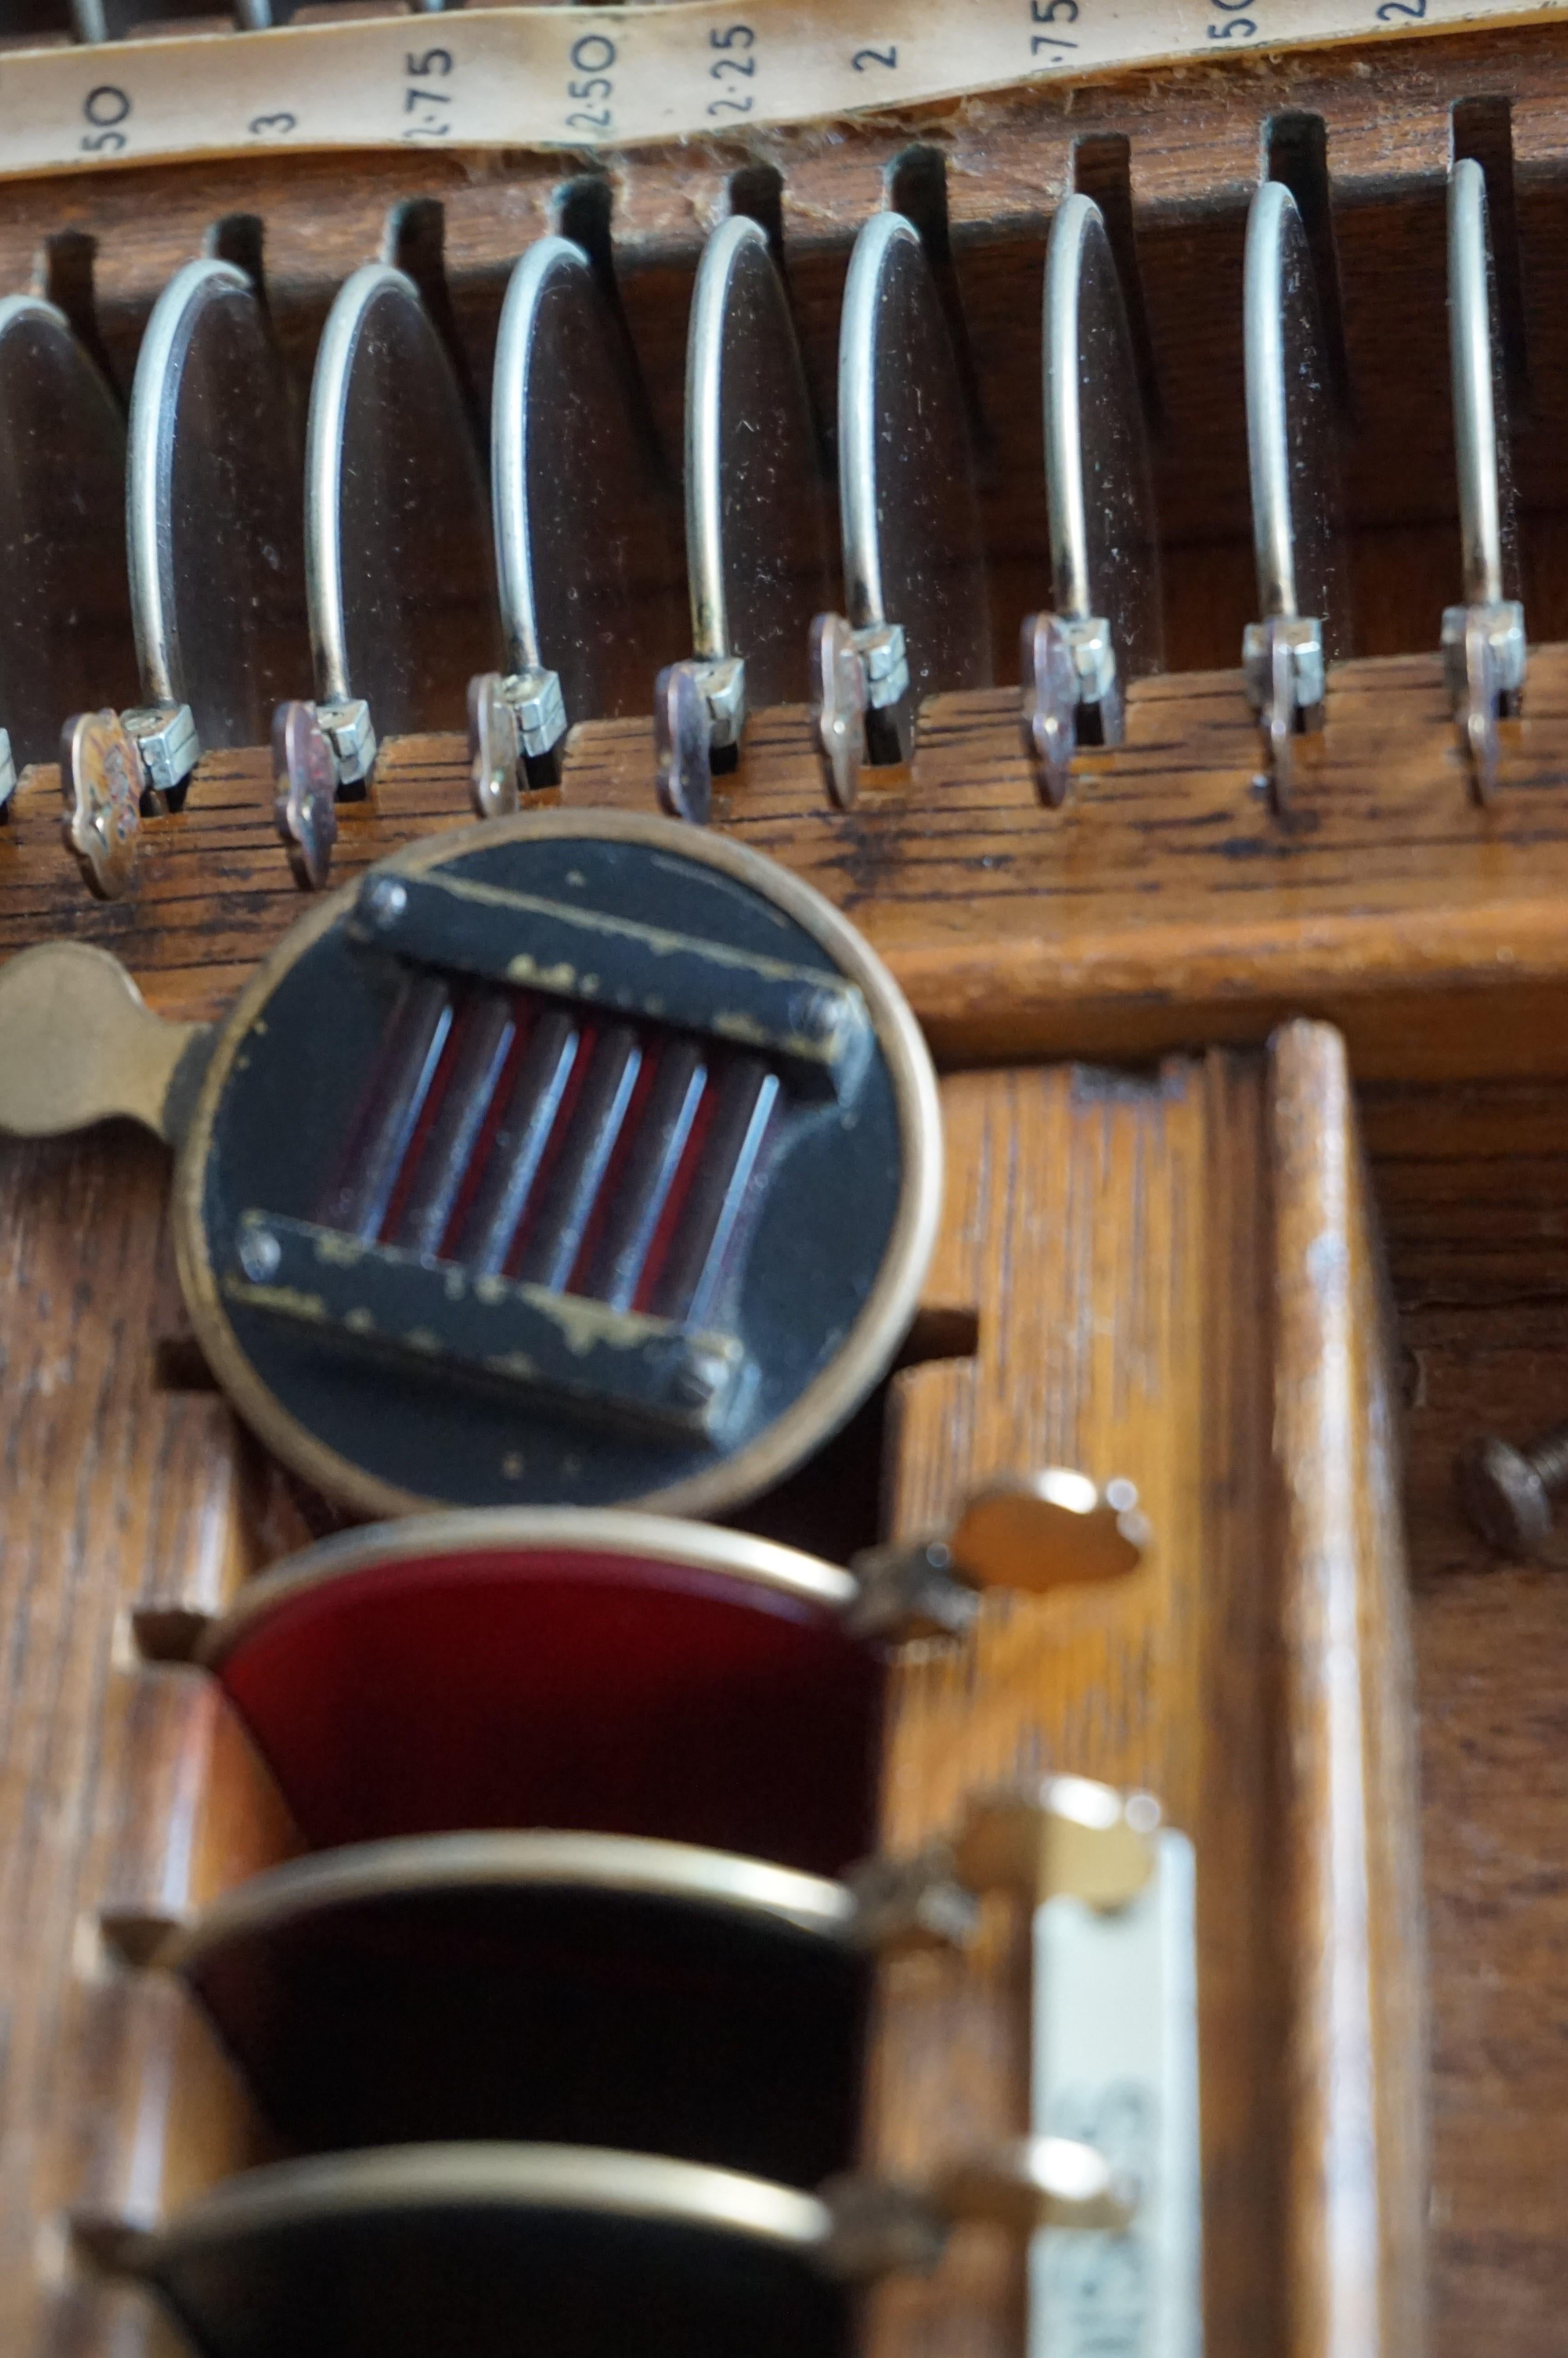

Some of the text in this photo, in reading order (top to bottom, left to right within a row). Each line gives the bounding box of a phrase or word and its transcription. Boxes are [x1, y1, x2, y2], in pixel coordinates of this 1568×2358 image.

[1207, 0, 1257, 38] 5
[851, 46, 896, 71] 2
[249, 113, 296, 134] 3
